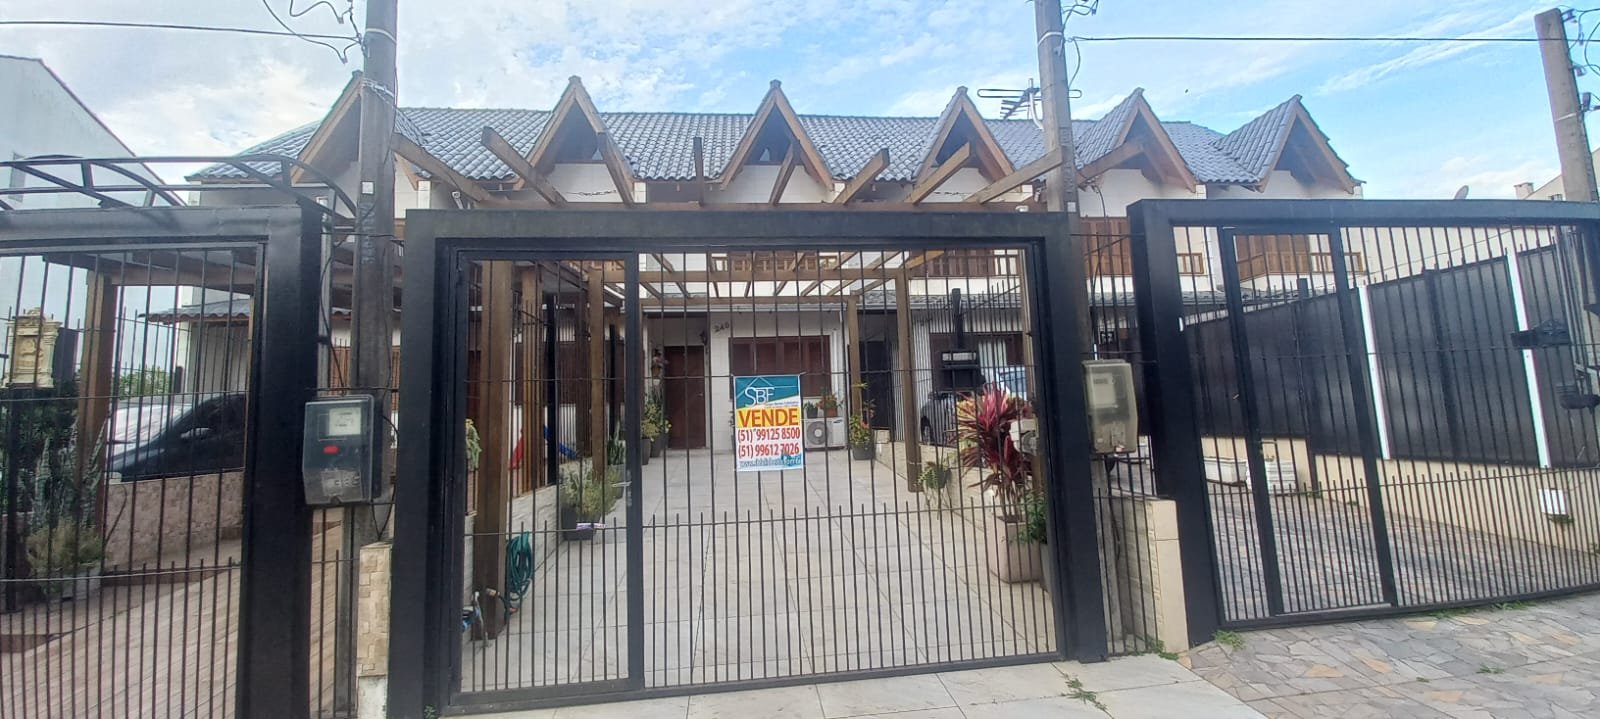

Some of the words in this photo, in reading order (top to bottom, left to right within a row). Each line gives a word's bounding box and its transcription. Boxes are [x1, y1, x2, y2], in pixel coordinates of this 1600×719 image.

[745, 387, 775, 407] SBF
[738, 408, 799, 428] VENDE
[738, 428, 752, 443] (51)
[757, 428, 780, 441] 99125
[781, 427, 800, 440] 8500
[738, 445, 753, 459] (51)
[755, 444, 779, 457] 99612
[781, 443, 800, 455] 7026
